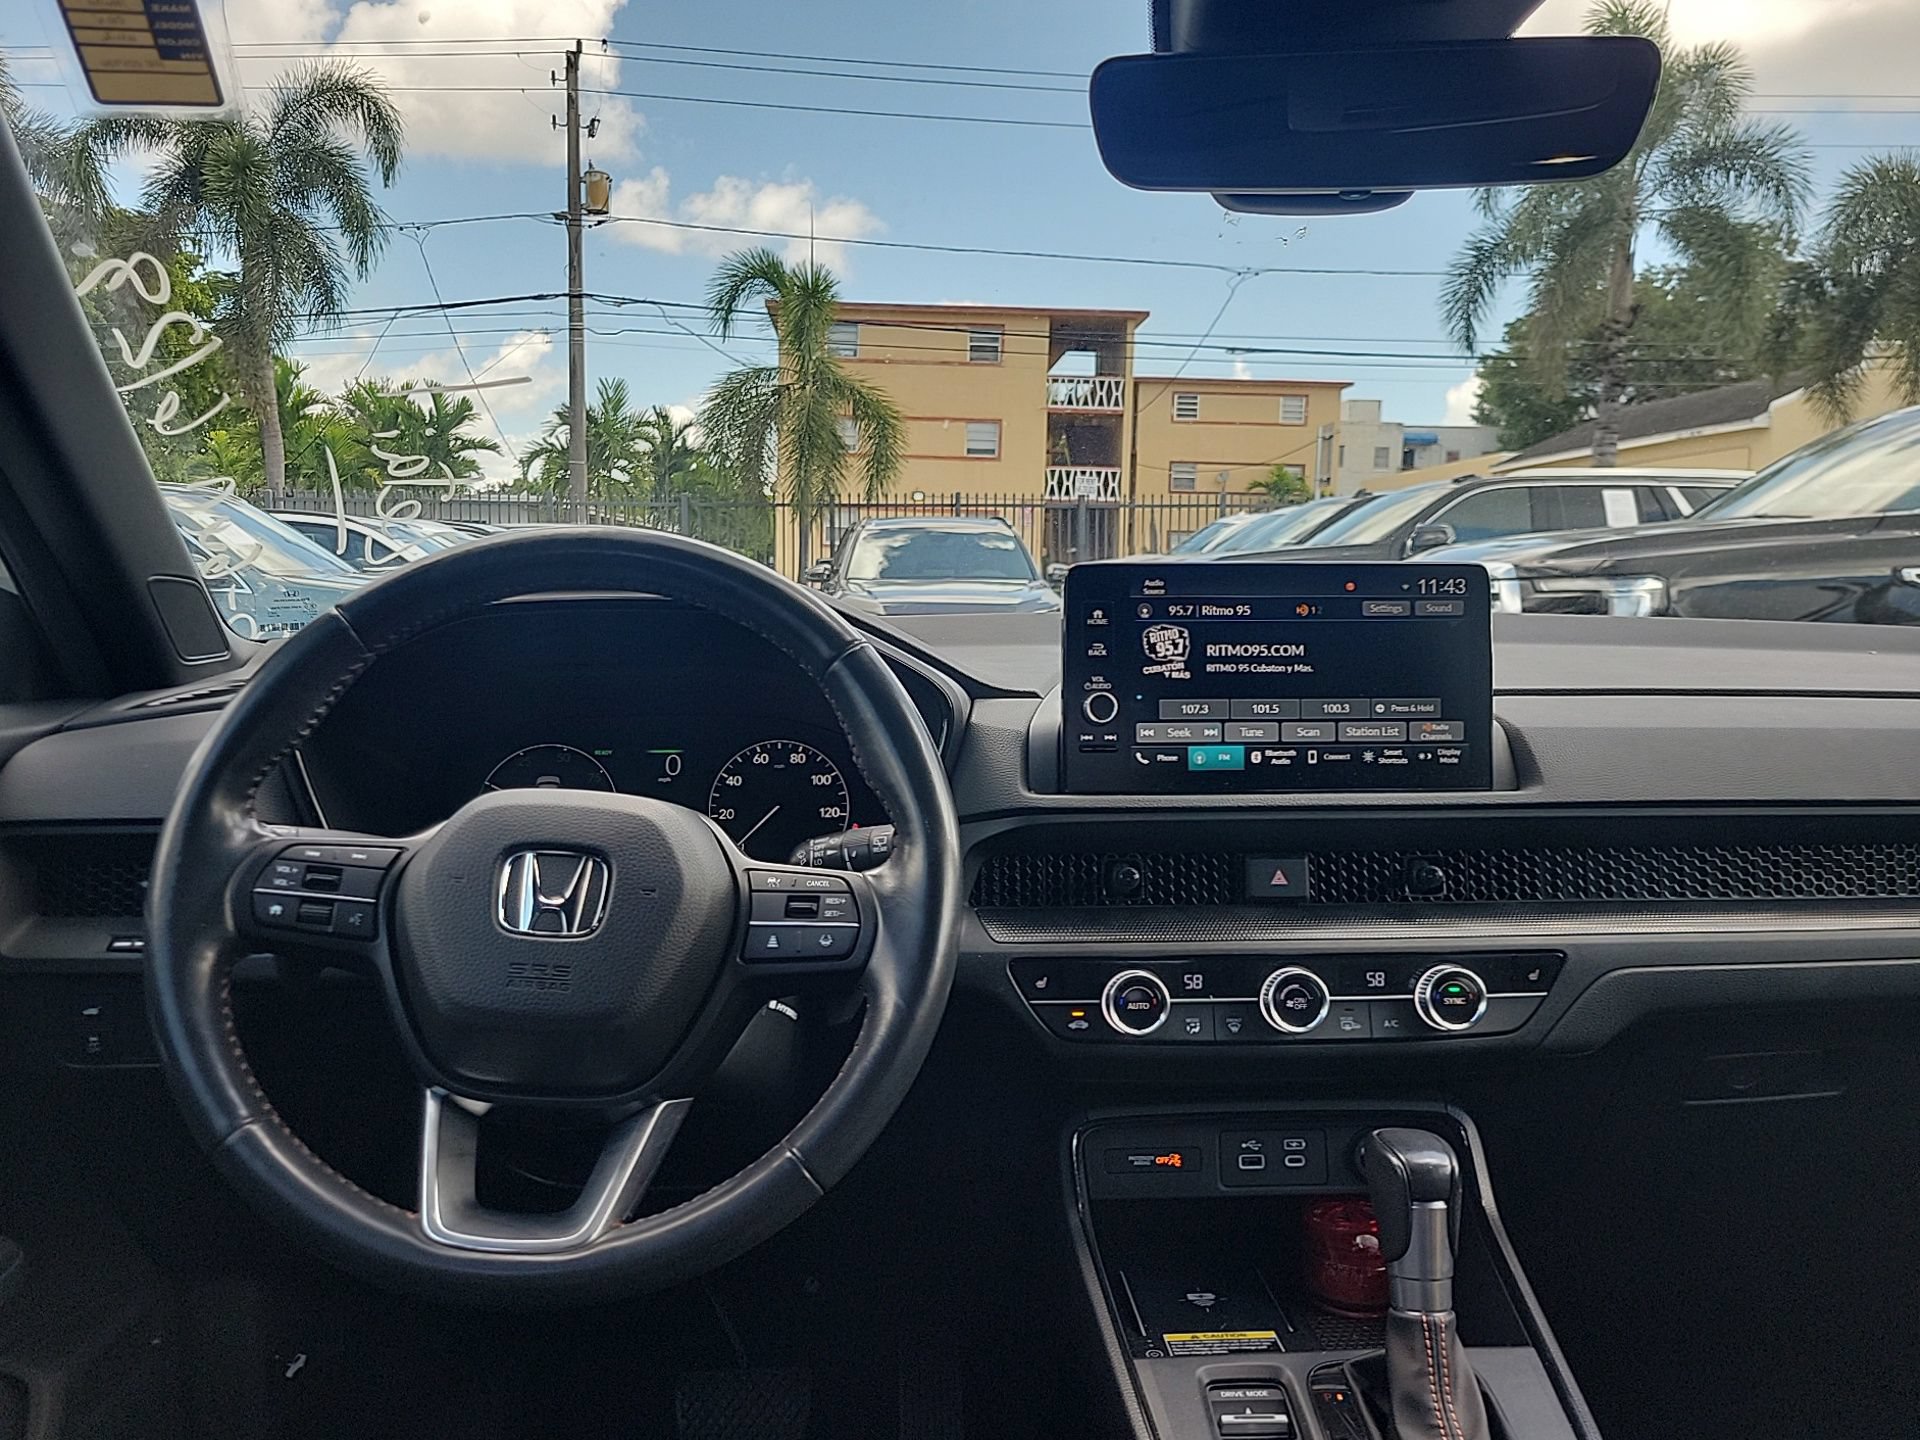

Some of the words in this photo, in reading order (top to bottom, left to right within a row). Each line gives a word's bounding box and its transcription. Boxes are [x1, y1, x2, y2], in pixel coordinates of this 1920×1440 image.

[1417, 578, 1467, 594] 11:43
[1168, 605, 1195, 616] 95.7
[1201, 604, 1234, 616] Ritmo
[1236, 605, 1251, 616] 95
[1370, 603, 1404, 615] Settings
[1425, 603, 1453, 613] Sound
[1149, 628, 1180, 643] RITMO
[1206, 645, 1305, 657] RITMO95.COM
[1206, 664, 1237, 673] RITMO
[1238, 664, 1250, 673] 95
[1251, 664, 1285, 673] Cubaton
[1286, 666, 1293, 674] y
[1294, 664, 1314, 673] Mas.
[1163, 671, 1171, 679] Y
[1180, 704, 1210, 714] 107.3
[1251, 704, 1280, 714] 101.5
[1322, 703, 1351, 714] 100.3
[1391, 704, 1410, 712] Press
[1418, 703, 1434, 712] Hold
[1167, 727, 1192, 738] Seek
[1239, 727, 1265, 738] Tune
[1297, 727, 1320, 737] Scan
[1346, 726, 1380, 737] Station
[1381, 726, 1400, 737] List
[753, 753, 769, 764] 60
[789, 753, 807, 764] 80
[1157, 754, 1179, 762] Phone
[665, 754, 682, 776] 0
[726, 775, 743, 786] 40
[811, 774, 832, 785] 100
[718, 809, 735, 820] 20
[819, 807, 841, 818] 120
[813, 858, 823, 866] LO
[508, 962, 572, 978] SRS
[1183, 974, 1203, 989] 58
[1366, 972, 1385, 987] 58
[1127, 1001, 1150, 1010] AUTO
[1443, 997, 1467, 1005] SYNC
[1202, 1332, 1248, 1340] CAUTION
[1220, 1390, 1245, 1398] DRIVE
[1245, 1389, 1269, 1397] MODE
